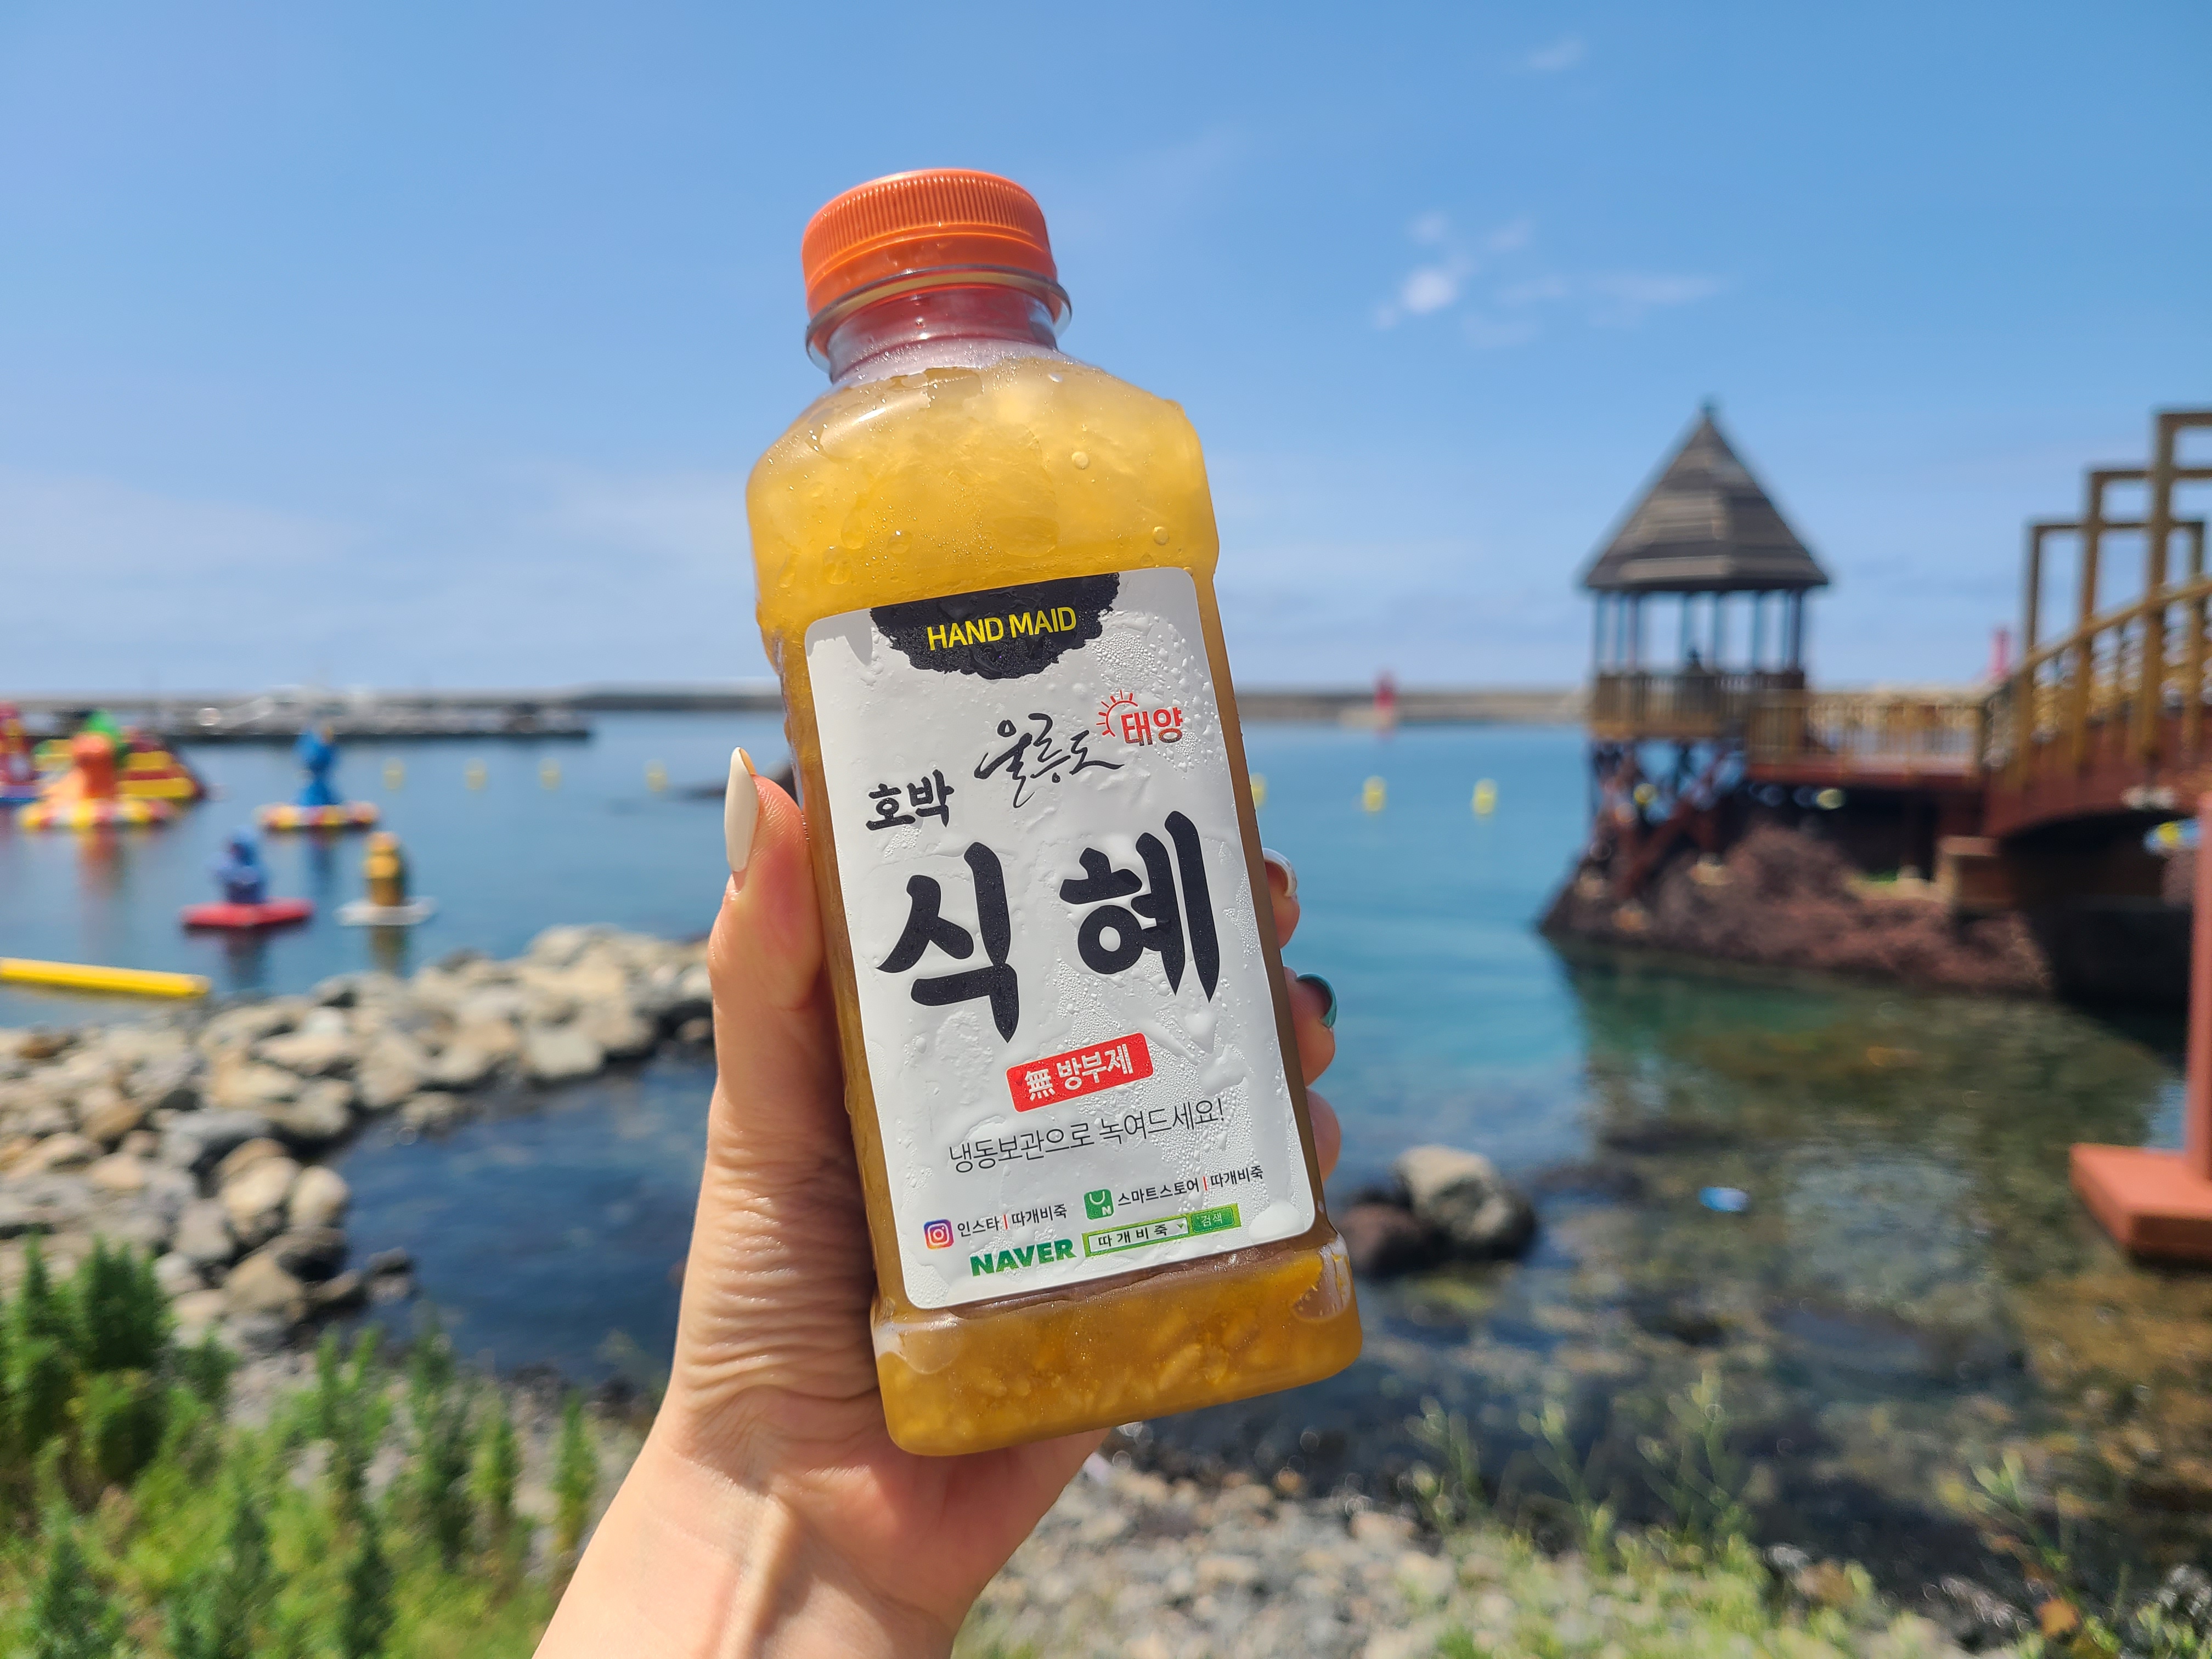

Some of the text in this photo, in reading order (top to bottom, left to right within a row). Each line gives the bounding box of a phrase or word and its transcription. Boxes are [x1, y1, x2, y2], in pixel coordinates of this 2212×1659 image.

[927, 607, 1076, 651] HAND MAID
[1121, 707, 1183, 746] 태양
[974, 713, 1125, 808] 울릉도
[865, 769, 954, 831] 호박
[1024, 1043, 1135, 1101] 無 방부제
[949, 1098, 1223, 1173] 냉동보관으로 녹여드세요!
[1118, 1165, 1263, 1206] 스마트스토어 따개비죽
[957, 1204, 1067, 1237] 인스타 따개비죽
[970, 1239, 1077, 1277] NAVER
